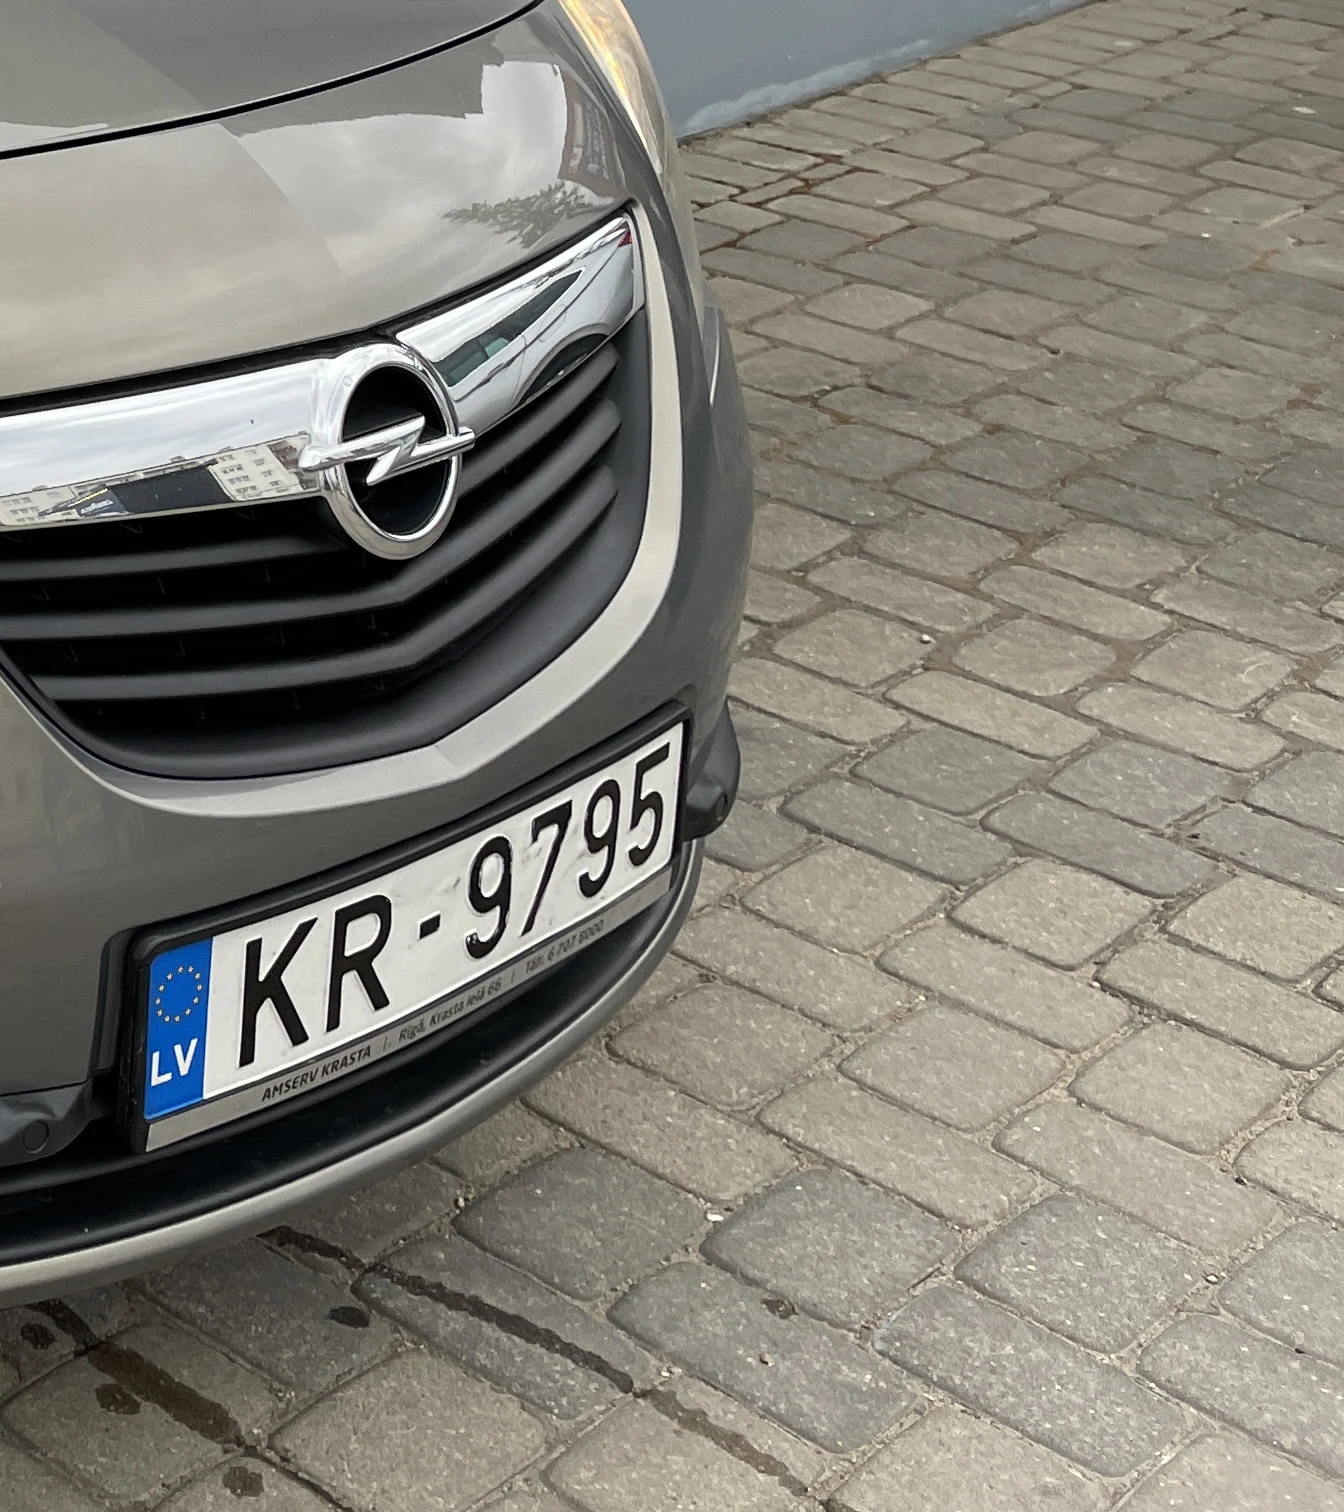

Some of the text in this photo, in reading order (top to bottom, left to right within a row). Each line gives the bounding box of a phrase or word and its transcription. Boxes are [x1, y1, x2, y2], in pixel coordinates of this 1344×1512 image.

[238, 741, 671, 1068] KR-9795
[150, 1037, 199, 1087] LV
[261, 1067, 318, 1101] AMSERV
[321, 1045, 372, 1079] KRASTA
